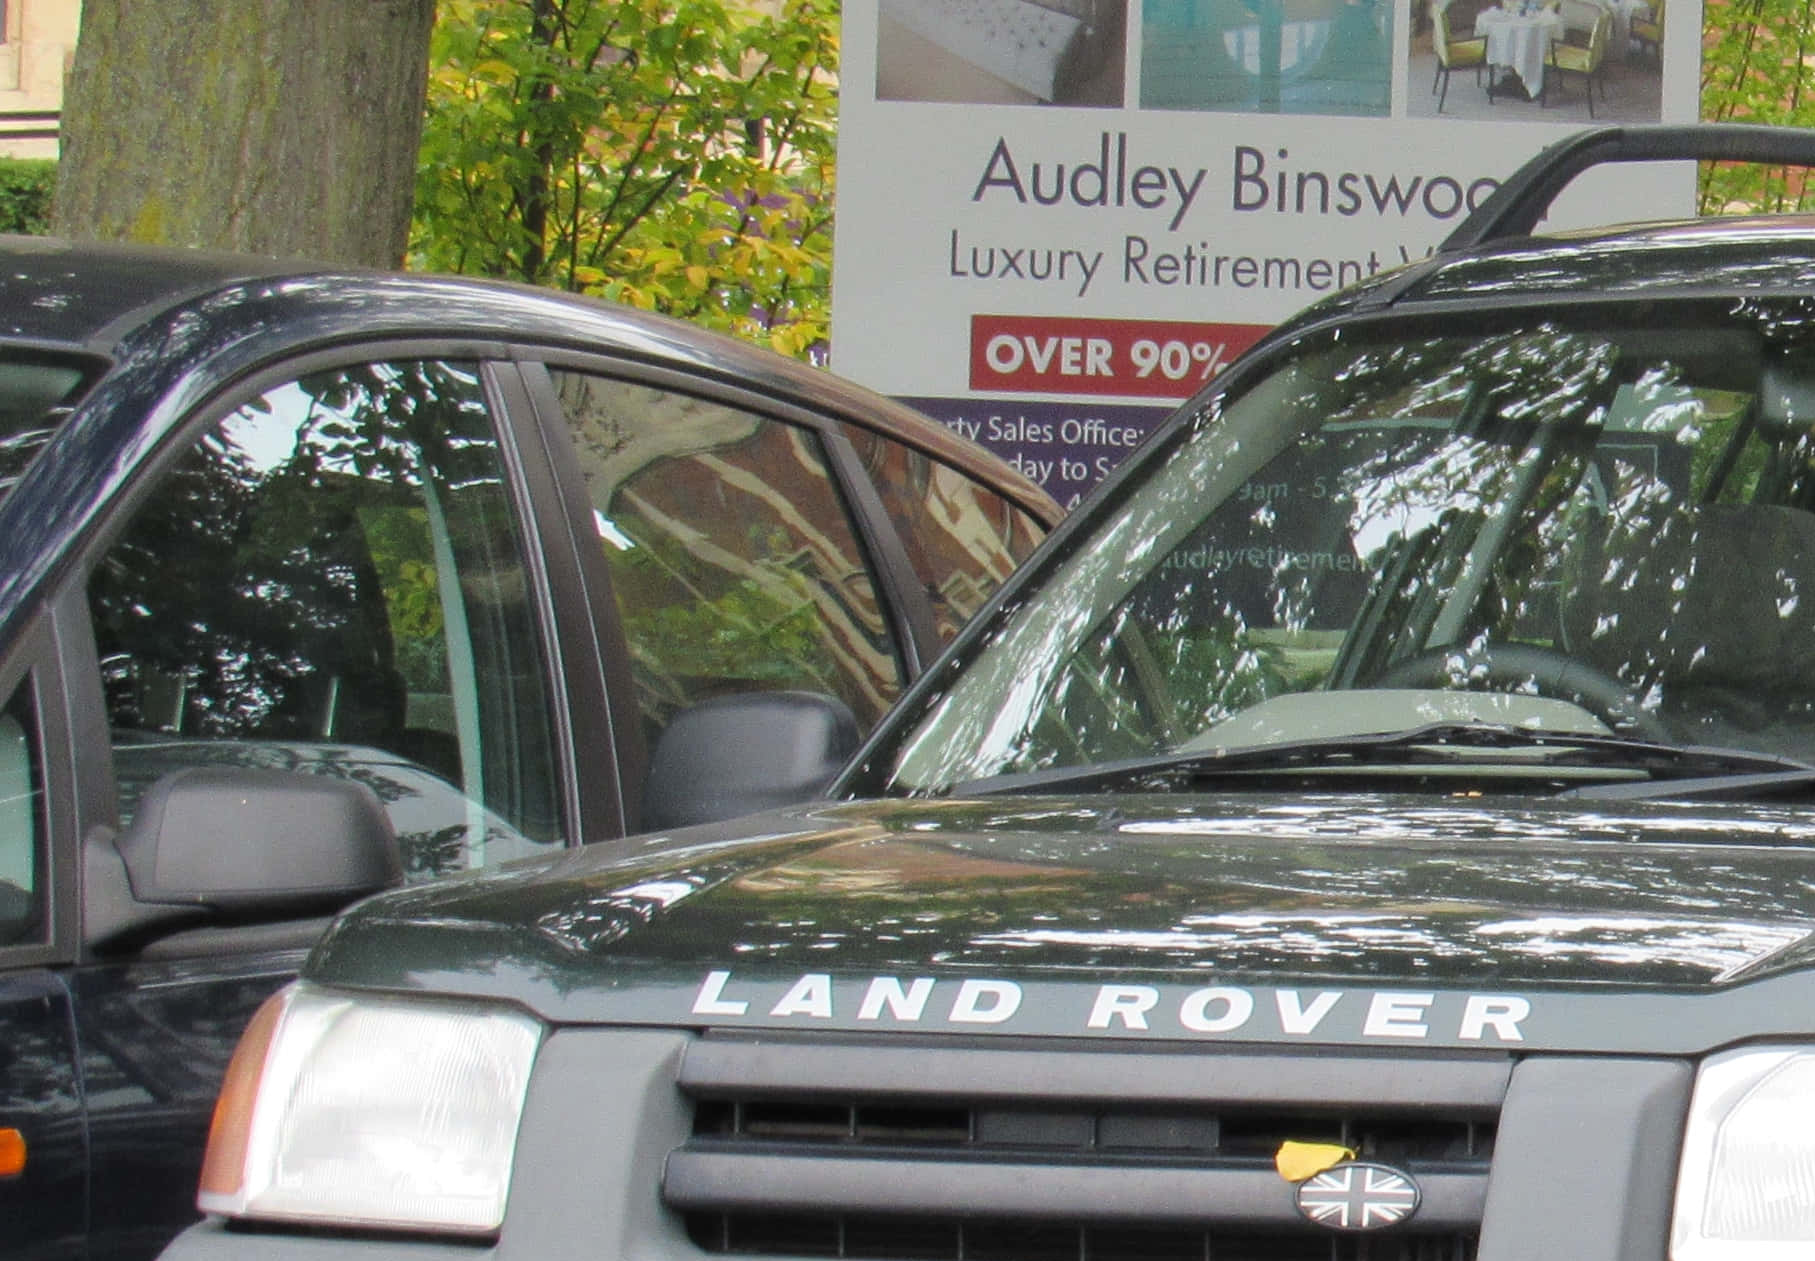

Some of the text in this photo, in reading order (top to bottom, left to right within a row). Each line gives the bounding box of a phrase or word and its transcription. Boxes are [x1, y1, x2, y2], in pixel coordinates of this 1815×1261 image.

[972, 131, 1548, 231] Audley Binswoo
[951, 229, 1381, 297] Luxury Retirement
[985, 334, 1230, 381] OVER 90%
[936, 416, 1145, 446] rty Sales Office:
[1061, 458, 1088, 481] to
[1095, 456, 1119, 482] S
[691, 970, 1532, 1042] LAND ROVER
